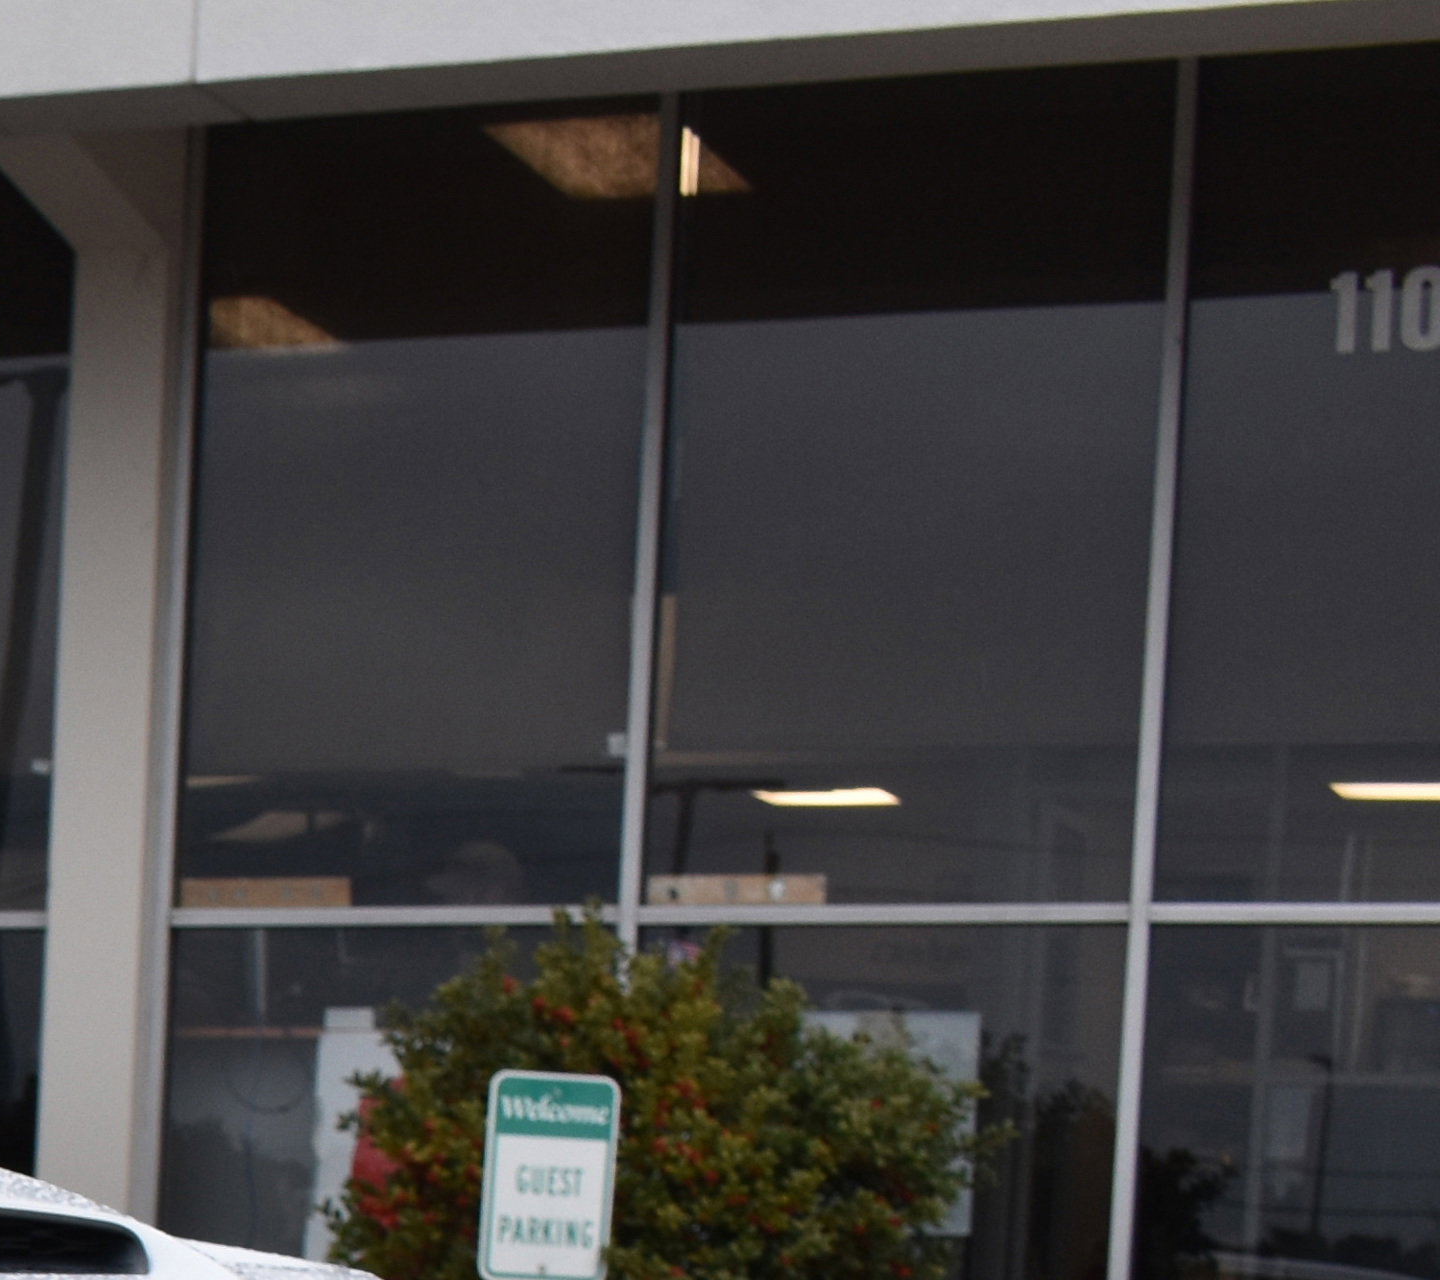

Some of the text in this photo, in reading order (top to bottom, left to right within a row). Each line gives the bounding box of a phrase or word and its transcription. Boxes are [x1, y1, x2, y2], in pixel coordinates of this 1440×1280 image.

[1328, 265, 1440, 354] 110
[500, 1093, 610, 1126] Welcome
[516, 1164, 584, 1197] GUEST
[497, 1215, 594, 1249] PARKING
